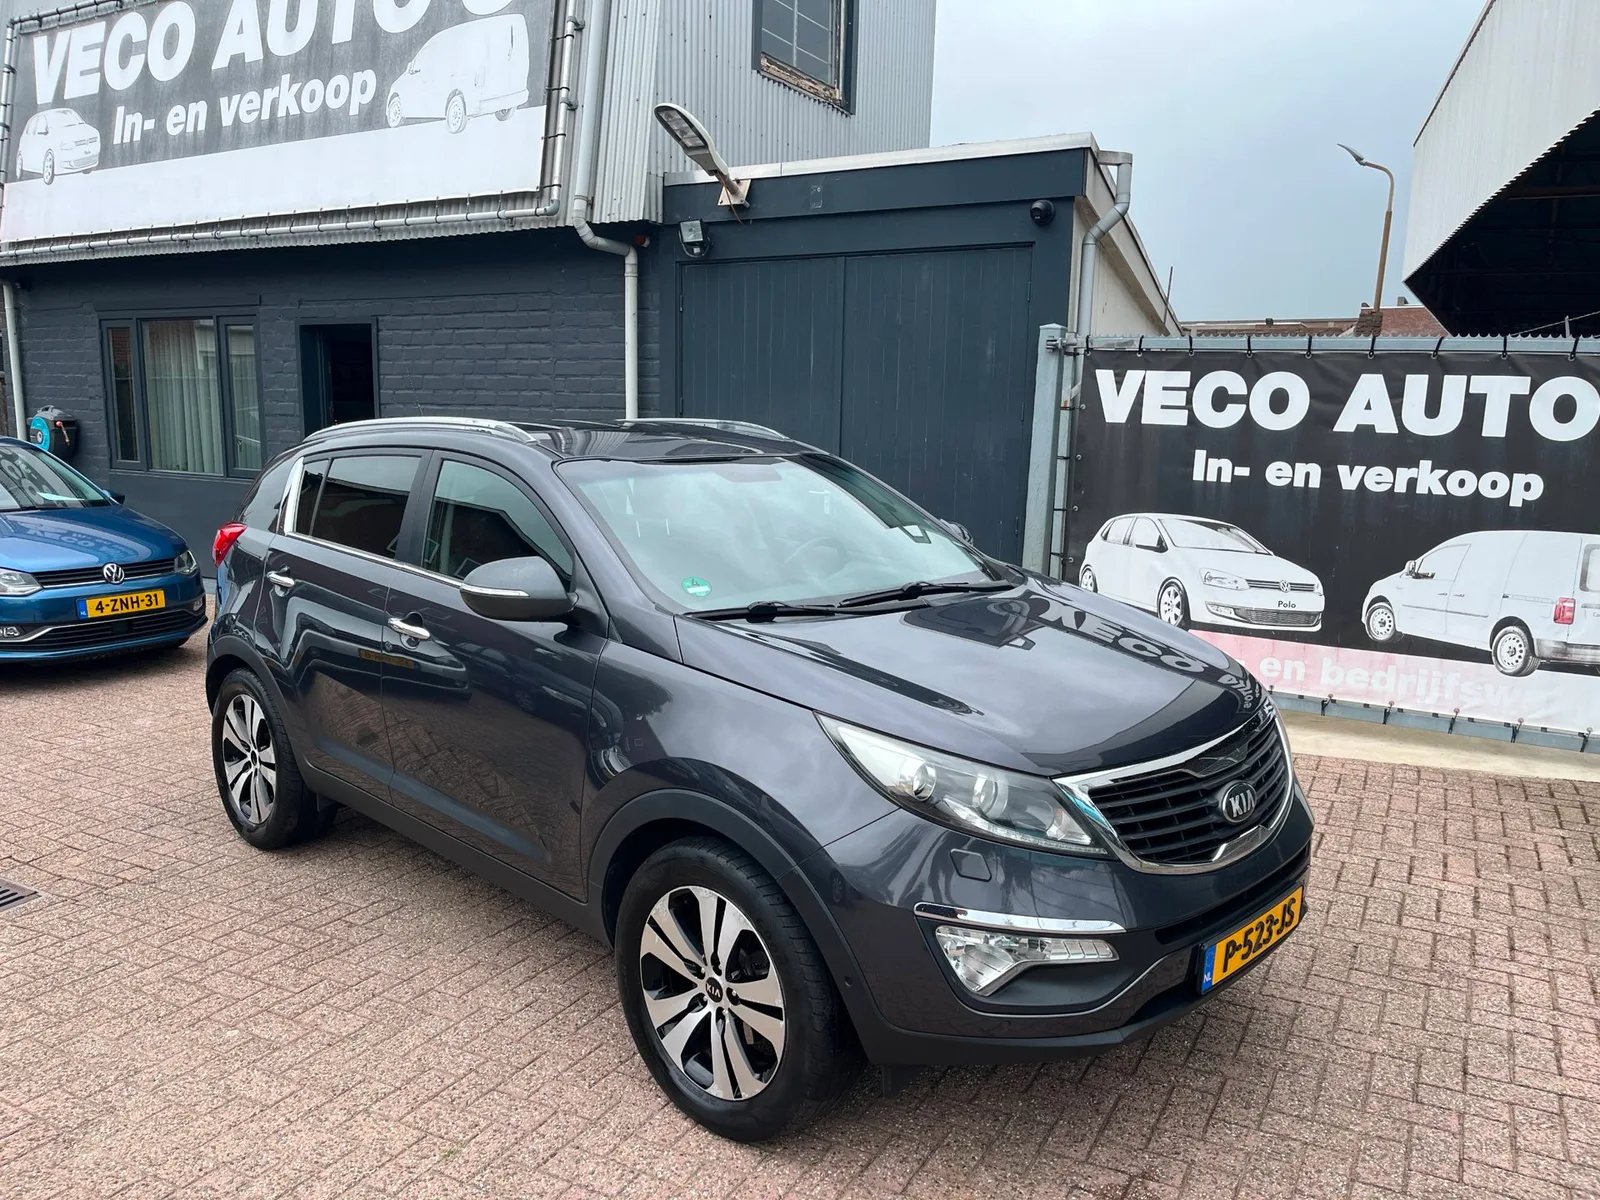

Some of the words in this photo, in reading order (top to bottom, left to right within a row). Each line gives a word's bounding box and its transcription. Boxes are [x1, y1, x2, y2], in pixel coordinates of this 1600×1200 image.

[33, 1, 196, 105] VECO
[113, 106, 155, 145] In-
[166, 100, 208, 136] en
[220, 69, 377, 127] verkoop
[1095, 369, 1310, 431] VECO
[1333, 373, 1600, 442] AUTO
[1193, 450, 1250, 483] In-
[1265, 460, 1321, 490] en
[1338, 460, 1545, 507] verkoop
[95, 592, 159, 614] 4-ZNH-31
[1277, 600, 1297, 609] Polo
[1259, 656, 1306, 681] en
[1229, 789, 1256, 818] KIA
[1222, 897, 1296, 973] P-523-JS
[706, 983, 721, 998] KIA
[1203, 974, 1212, 983] NL
